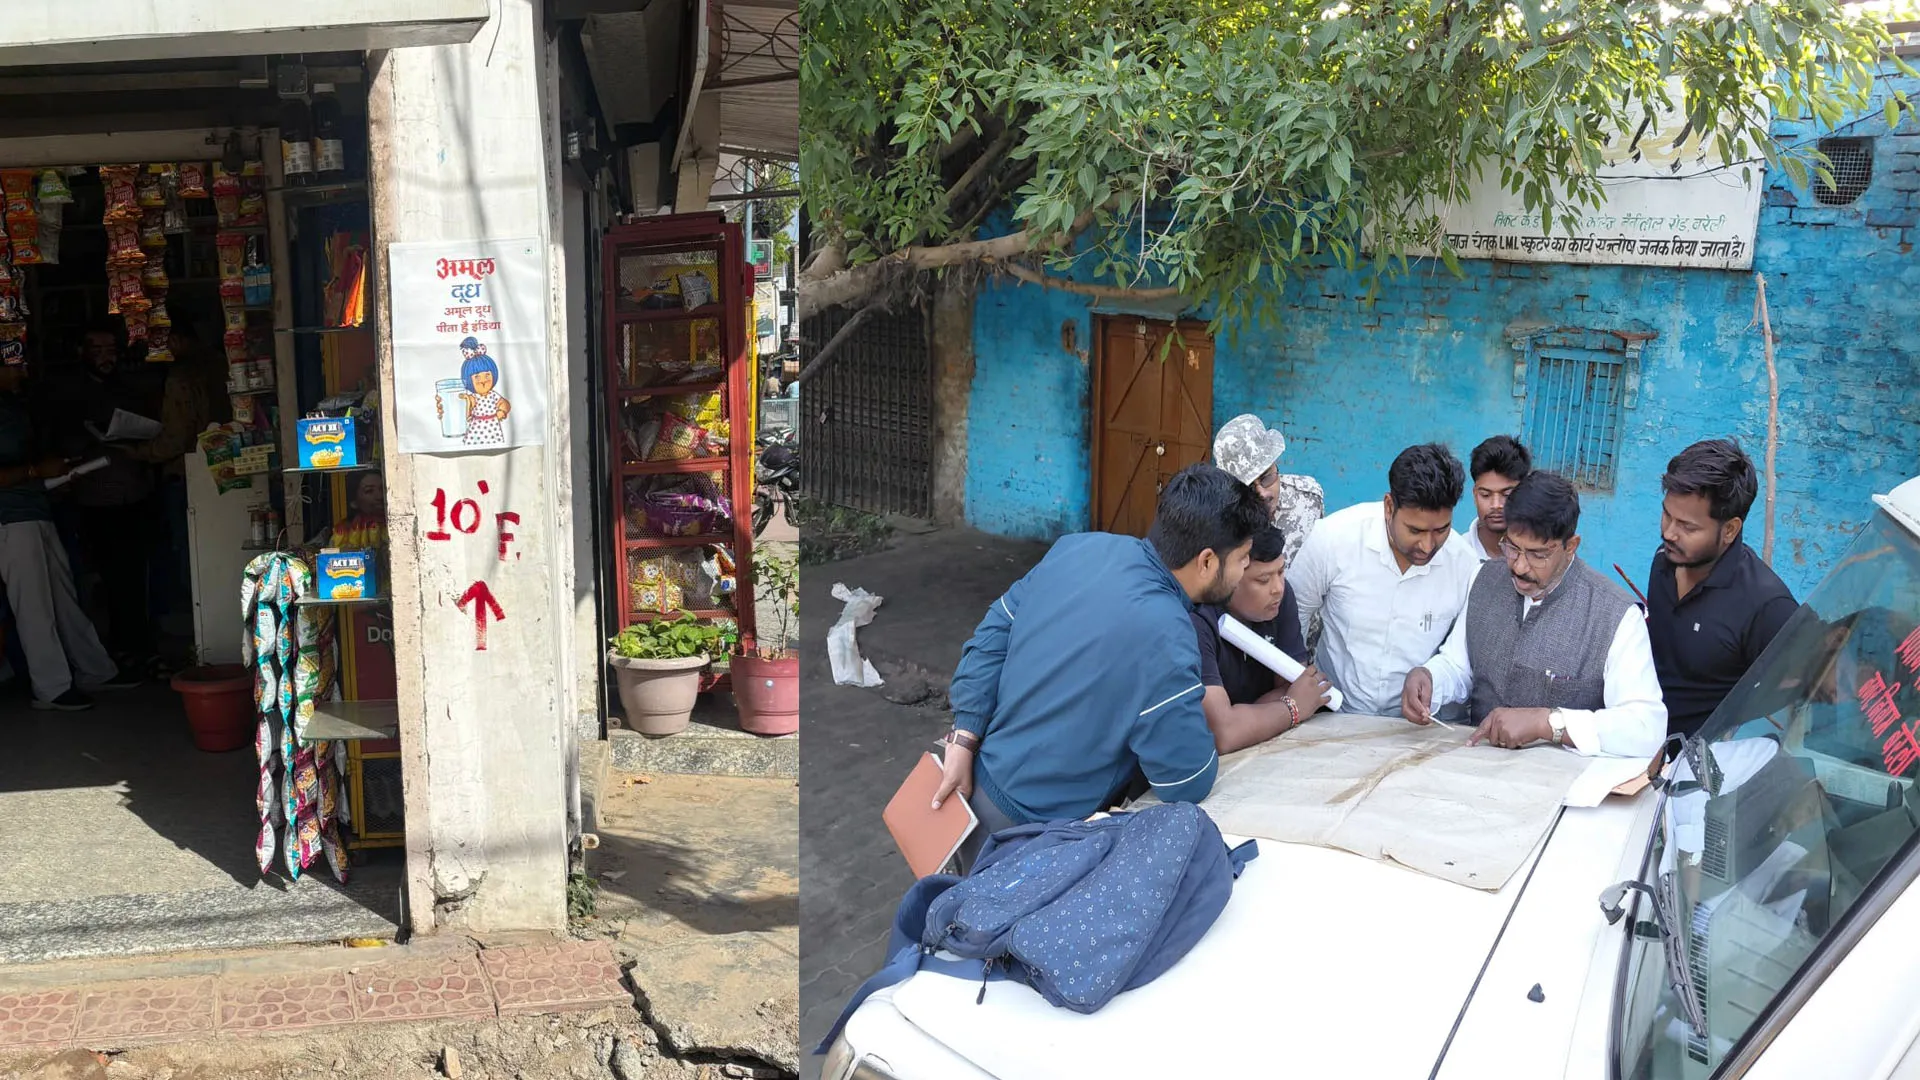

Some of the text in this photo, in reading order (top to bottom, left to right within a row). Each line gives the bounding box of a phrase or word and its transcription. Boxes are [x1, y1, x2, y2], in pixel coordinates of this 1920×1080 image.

[1500, 236, 1519, 250] LML
[1551, 237, 1567, 252] का
[1568, 233, 1594, 253] कार्य
[1637, 239, 1671, 256] जनक
[1671, 235, 1698, 256] किया
[1699, 240, 1731, 258] जाता
[436, 257, 495, 280] अमूल
[451, 283, 482, 303] दूध
[444, 305, 492, 318] अमूल दूध
[436, 319, 501, 333] पीता है इंडिया
[312, 423, 327, 432] ACT
